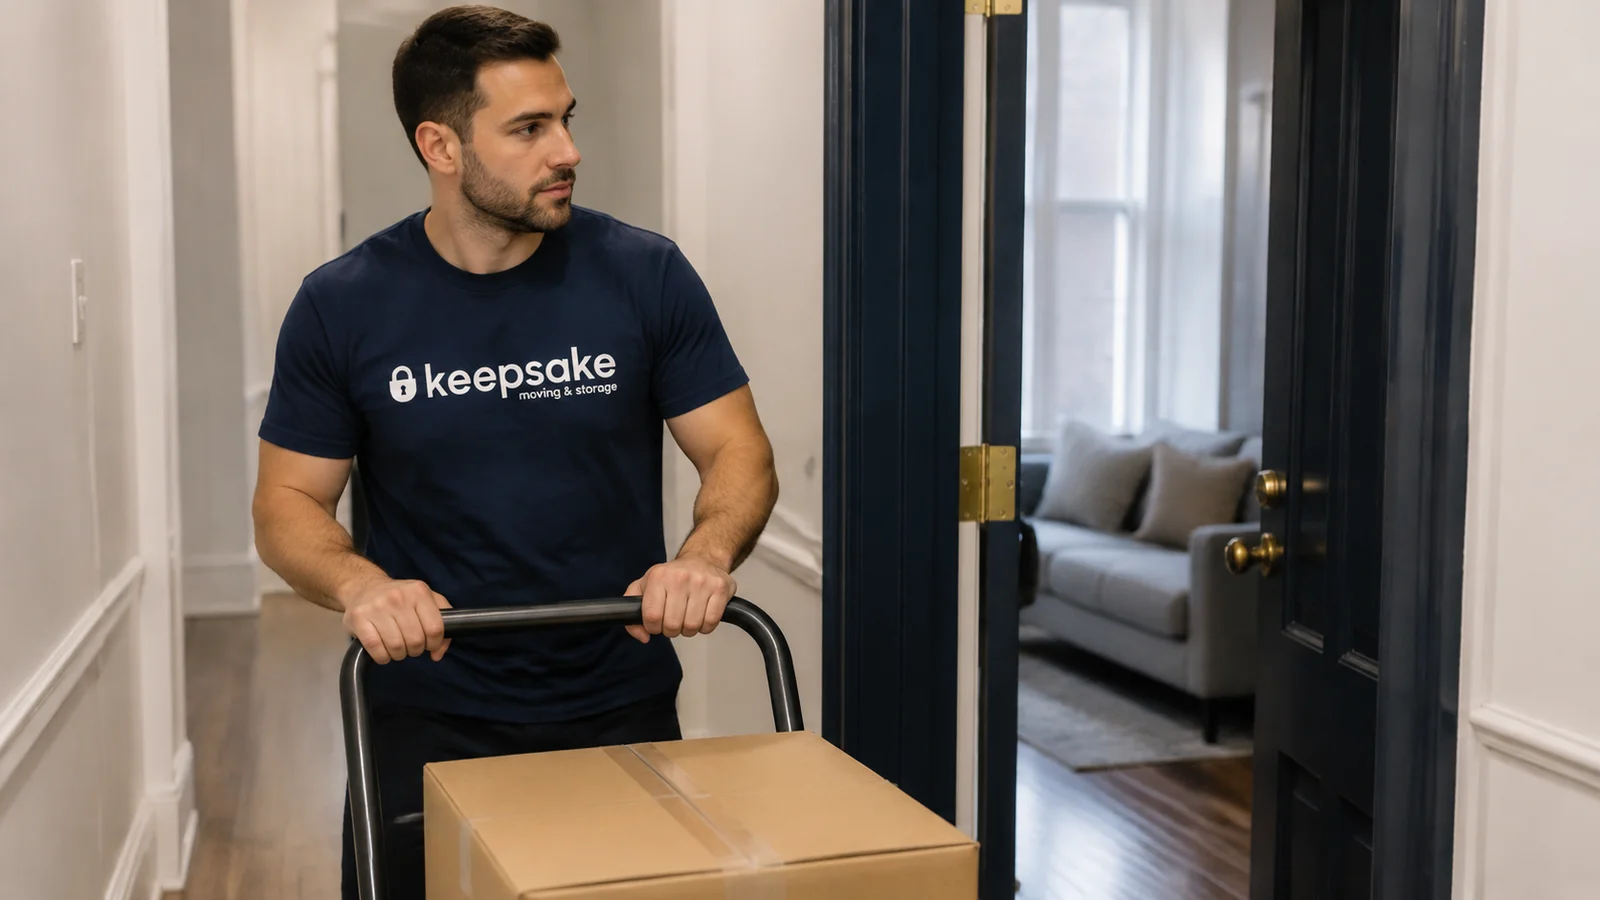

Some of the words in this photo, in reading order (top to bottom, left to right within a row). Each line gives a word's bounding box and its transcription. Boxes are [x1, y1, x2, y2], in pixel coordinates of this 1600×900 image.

[424, 346, 616, 399] keepsake
[519, 387, 561, 400] moving
[563, 386, 573, 396] &
[575, 383, 618, 395] storage
